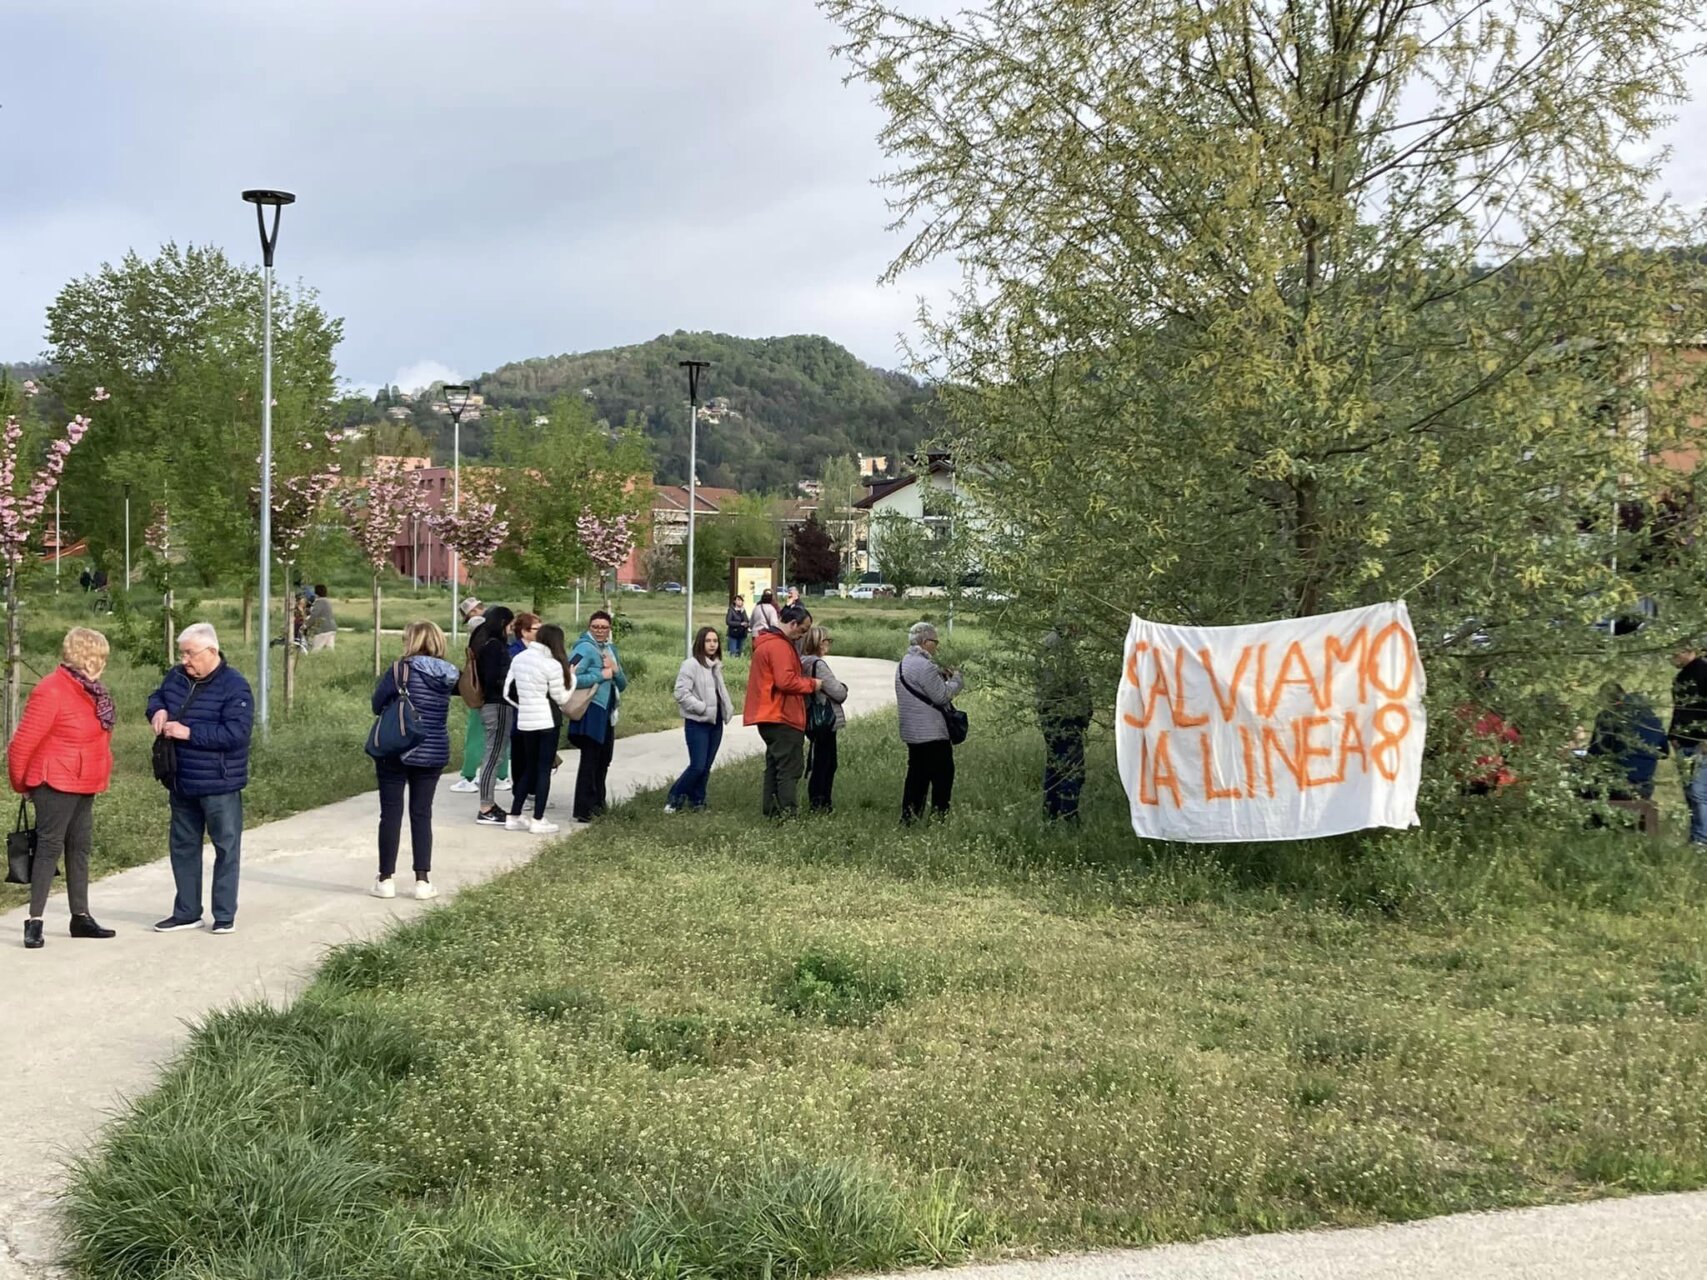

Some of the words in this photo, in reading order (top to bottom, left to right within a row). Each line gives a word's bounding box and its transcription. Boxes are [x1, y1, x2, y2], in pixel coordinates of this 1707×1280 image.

[1123, 621, 1413, 728] SALVIAMO
[1139, 730, 1182, 809] LA
[1200, 710, 1368, 800] LINEA
[1371, 702, 1411, 782] 8
